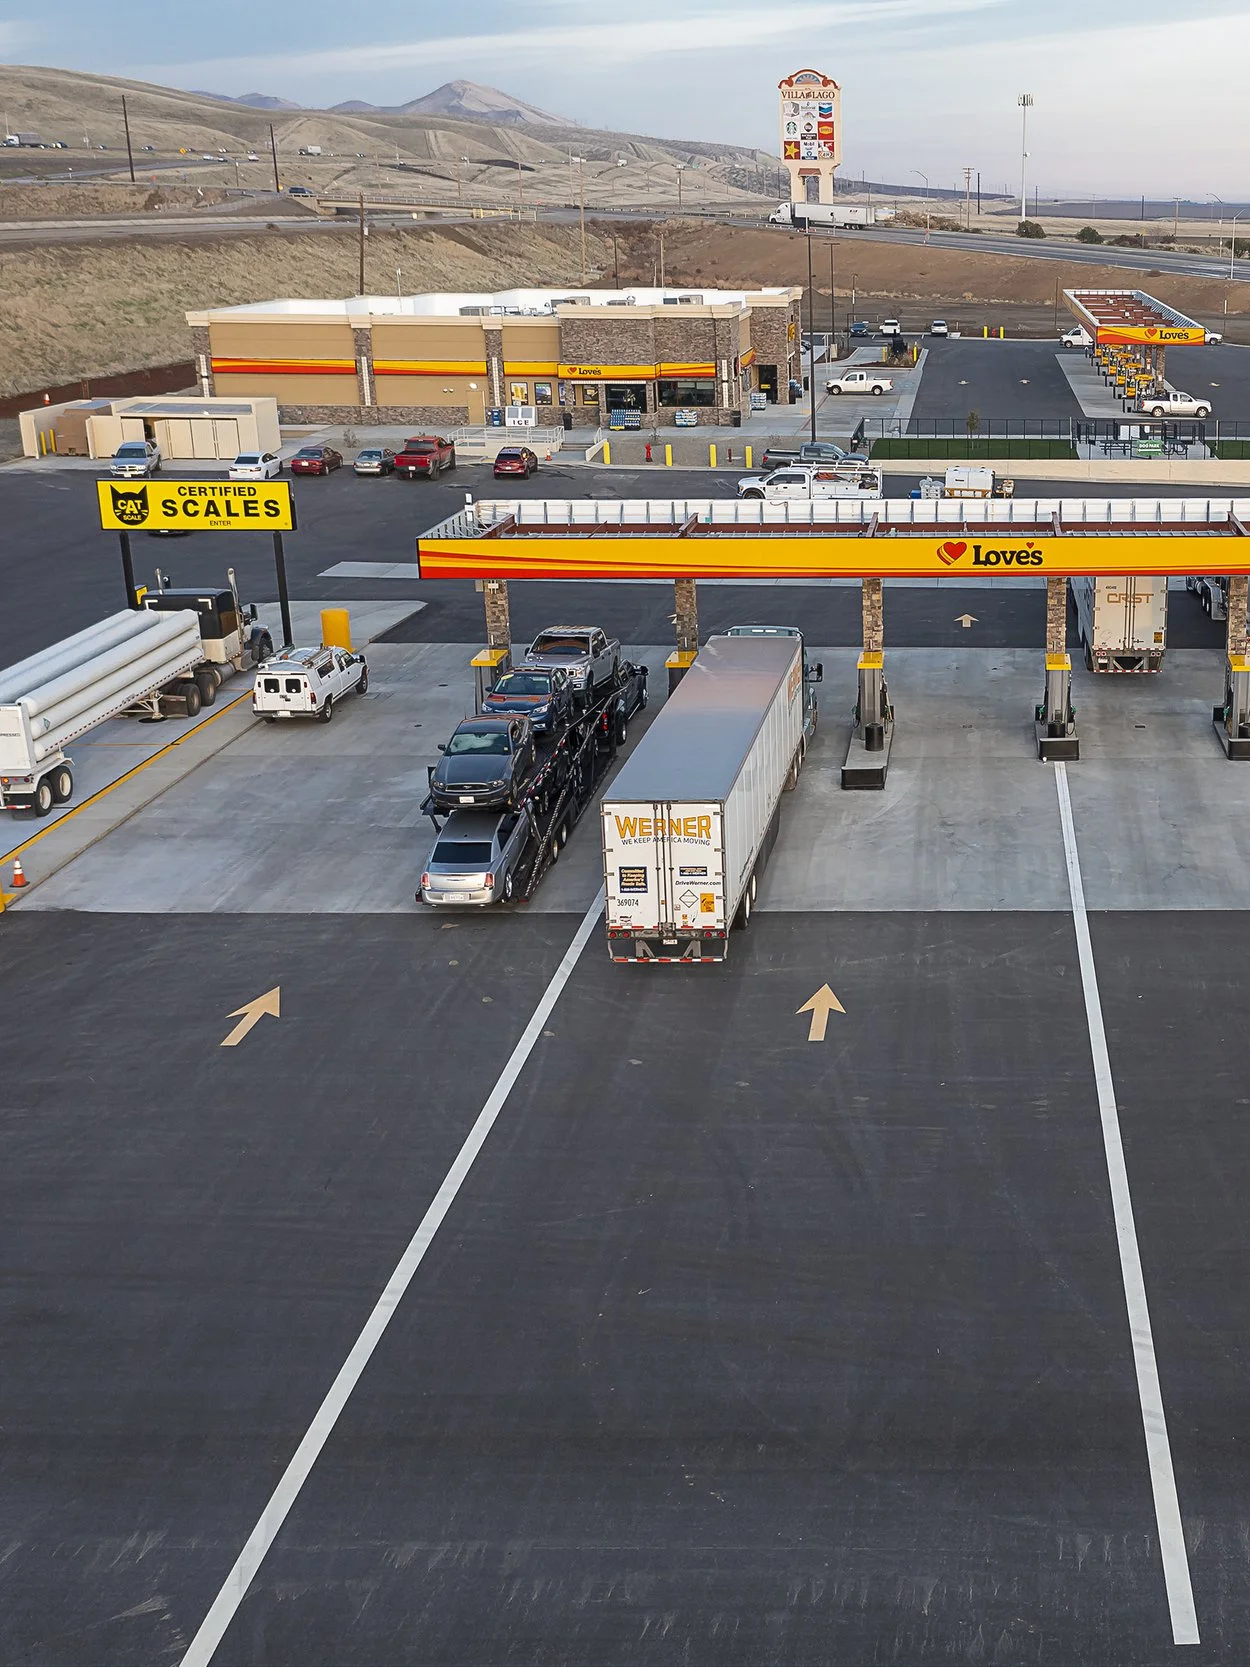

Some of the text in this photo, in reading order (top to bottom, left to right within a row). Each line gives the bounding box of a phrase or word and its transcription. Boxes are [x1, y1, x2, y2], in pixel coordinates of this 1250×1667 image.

[177, 486, 257, 496] CERTIFIED
[118, 500, 142, 514] CAT
[162, 499, 280, 518] SCALES
[973, 542, 1043, 566] Love's
[615, 815, 711, 839] WERNER
[683, 838, 710, 846] MOVING
